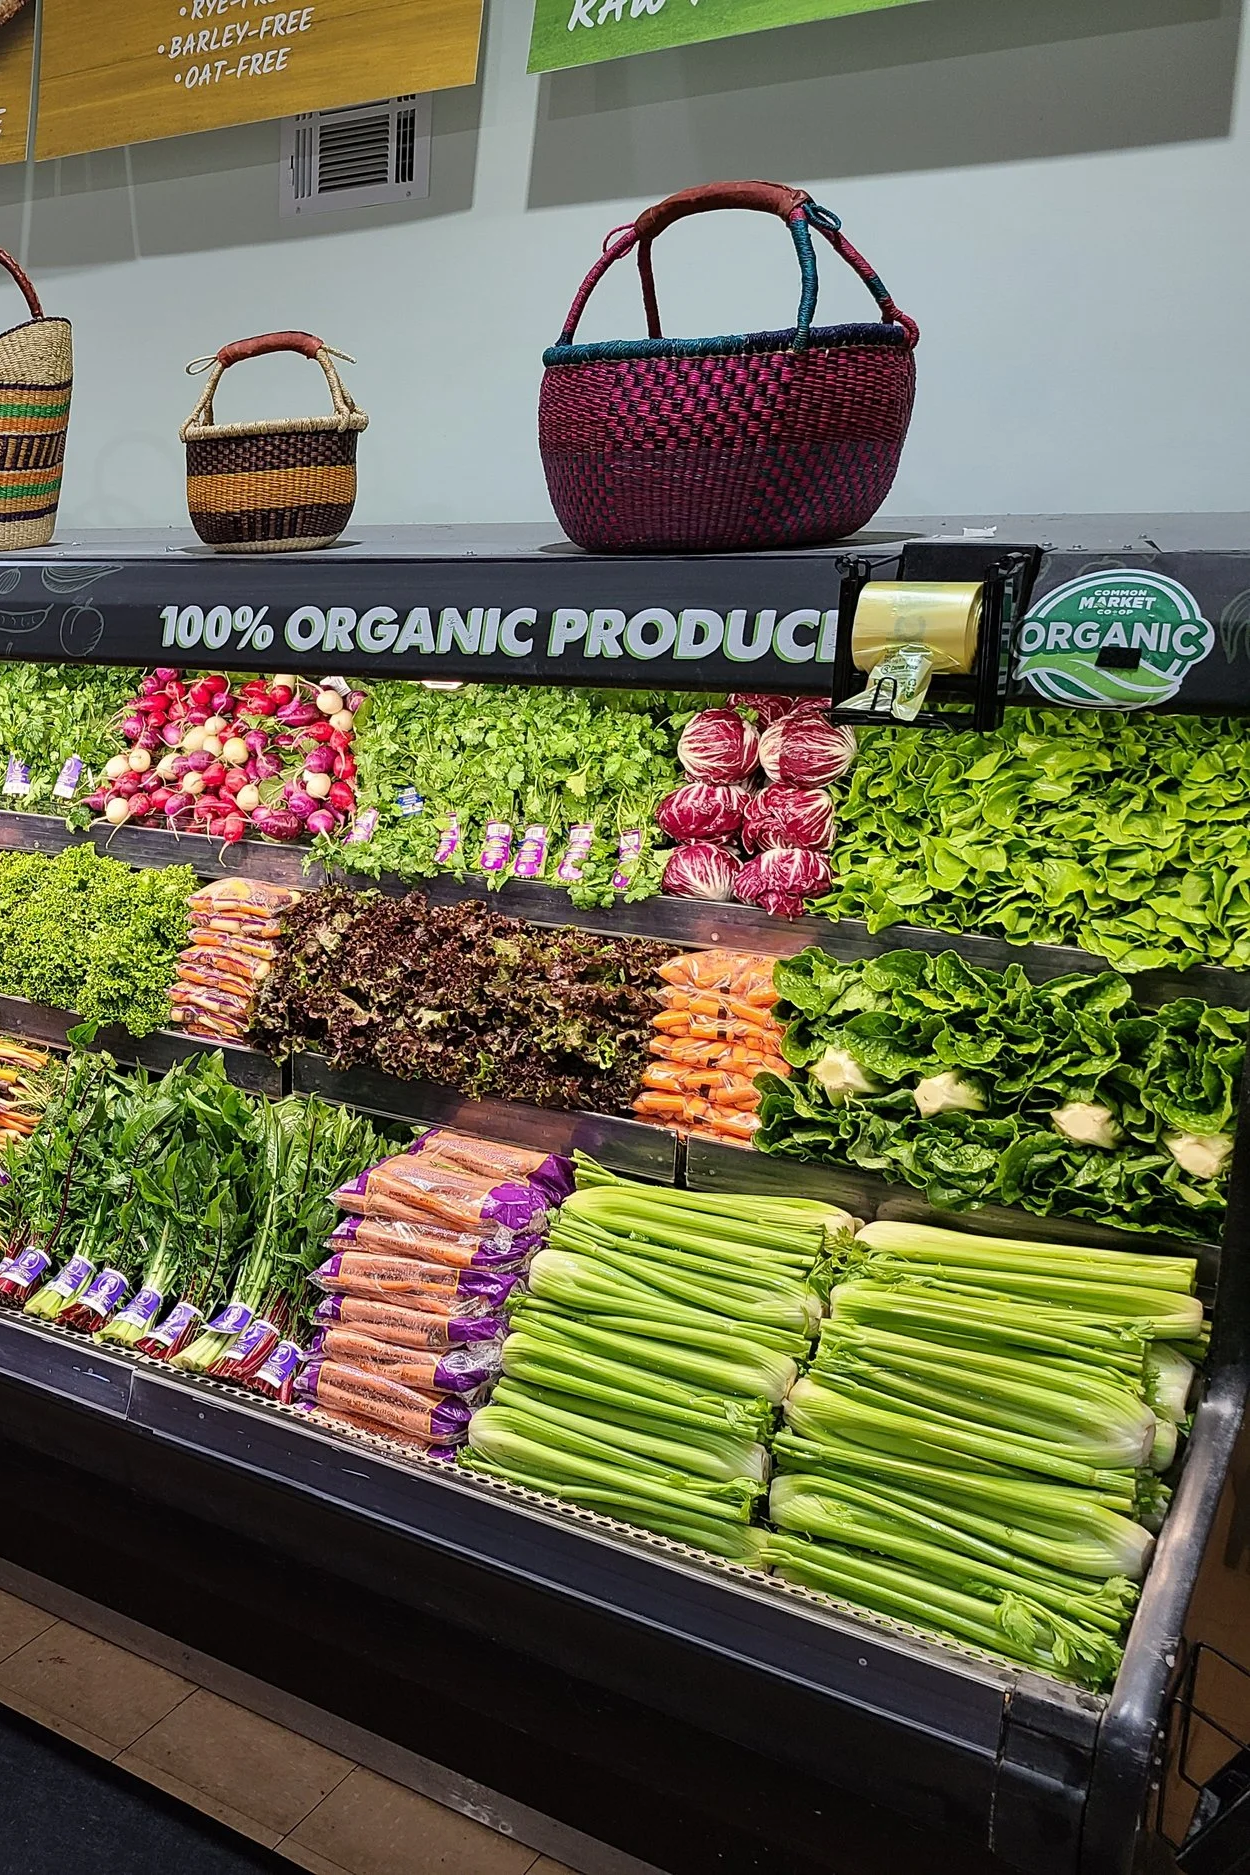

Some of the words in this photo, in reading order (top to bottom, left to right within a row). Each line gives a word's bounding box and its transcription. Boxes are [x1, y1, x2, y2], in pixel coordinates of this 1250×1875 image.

[168, 7, 315, 59] BARLEY-FREE
[184, 47, 291, 89] OAT-FREE
[1078, 596, 1157, 610] MARKET
[1094, 589, 1148, 597] COMMON
[161, 605, 273, 650] 100%
[284, 607, 536, 658] ORGANIC
[1019, 621, 1200, 656] ORGANIC
